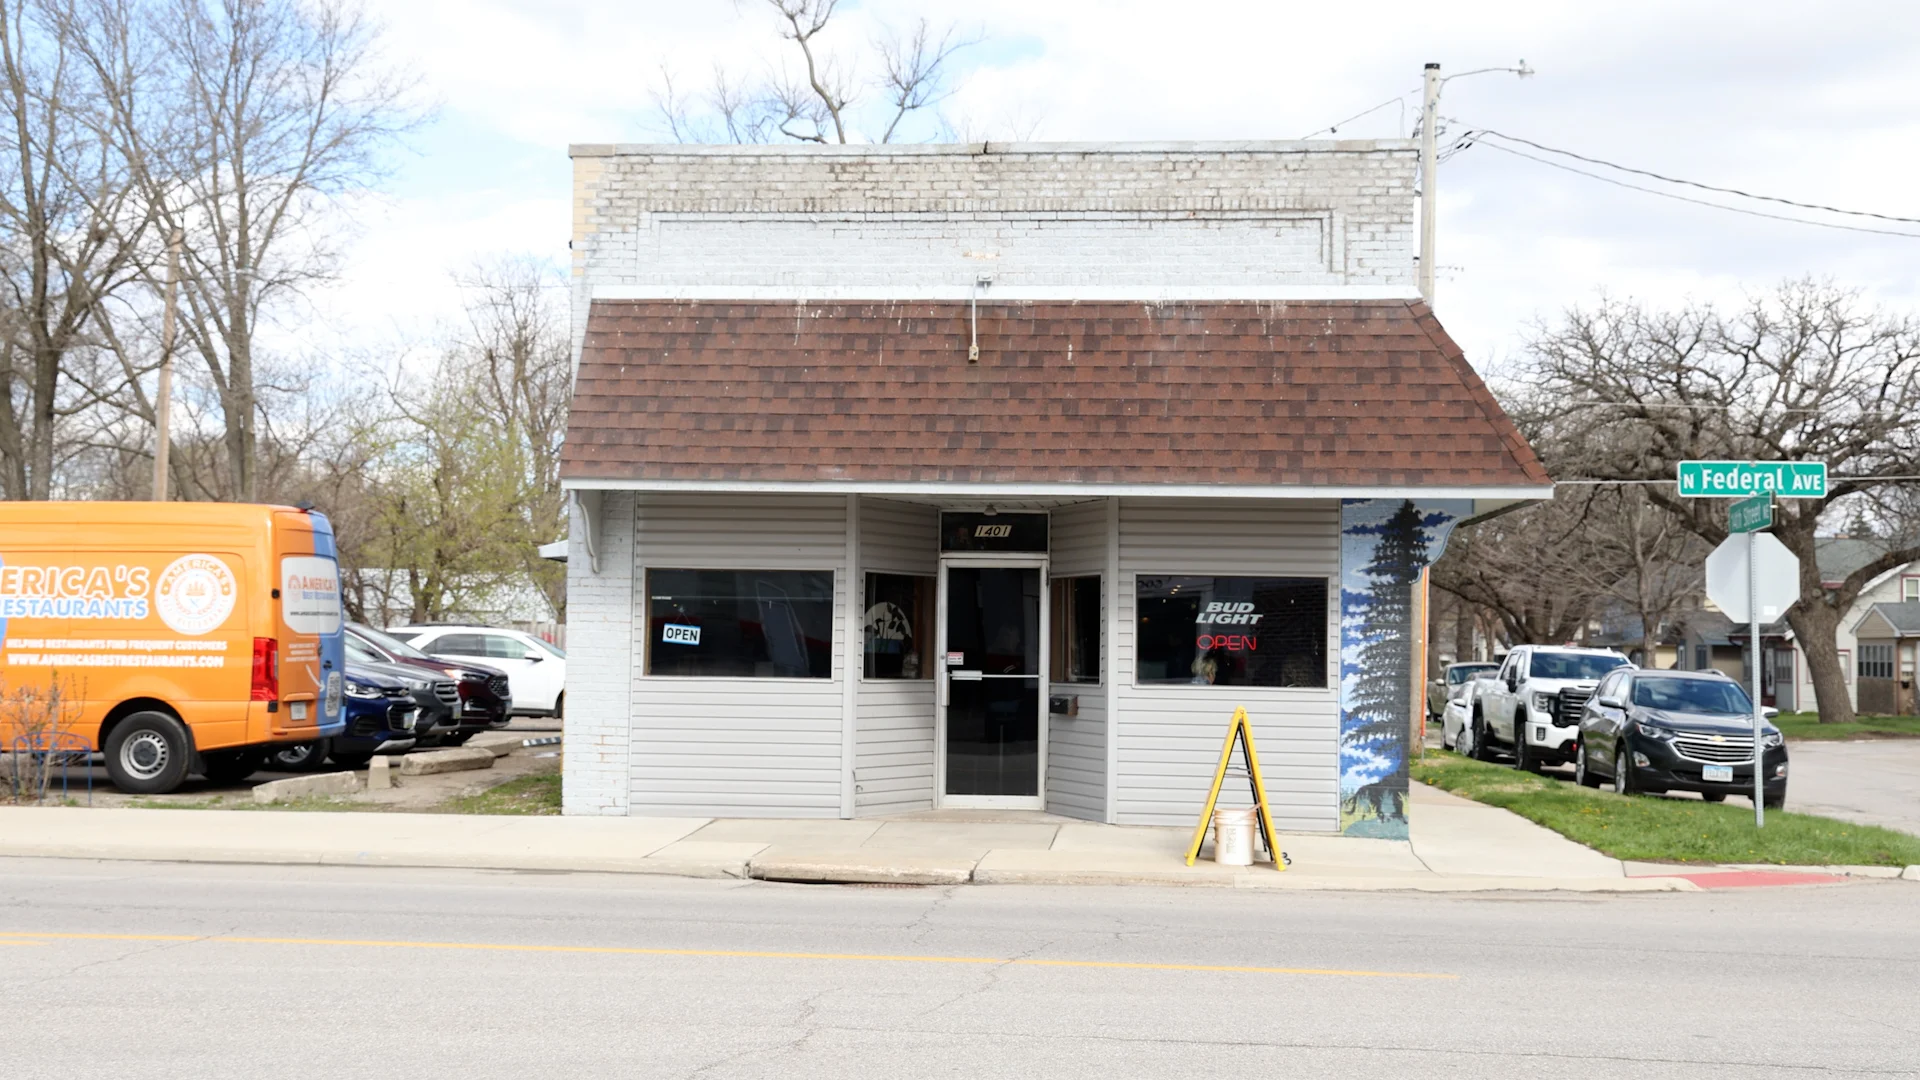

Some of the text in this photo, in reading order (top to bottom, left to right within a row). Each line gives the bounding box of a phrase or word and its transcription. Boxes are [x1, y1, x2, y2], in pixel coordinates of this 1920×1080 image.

[1683, 467, 1822, 491] N Federal AVE
[1743, 502, 1761, 527] Street
[978, 526, 1008, 536] 1401
[0, 565, 149, 599] ERICA'S
[0, 599, 148, 618] ESTAURANTS
[1205, 601, 1255, 613] BUD
[1195, 613, 1264, 625] LIGHT
[666, 627, 698, 642] OPEN
[1196, 634, 1257, 651] OPEN
